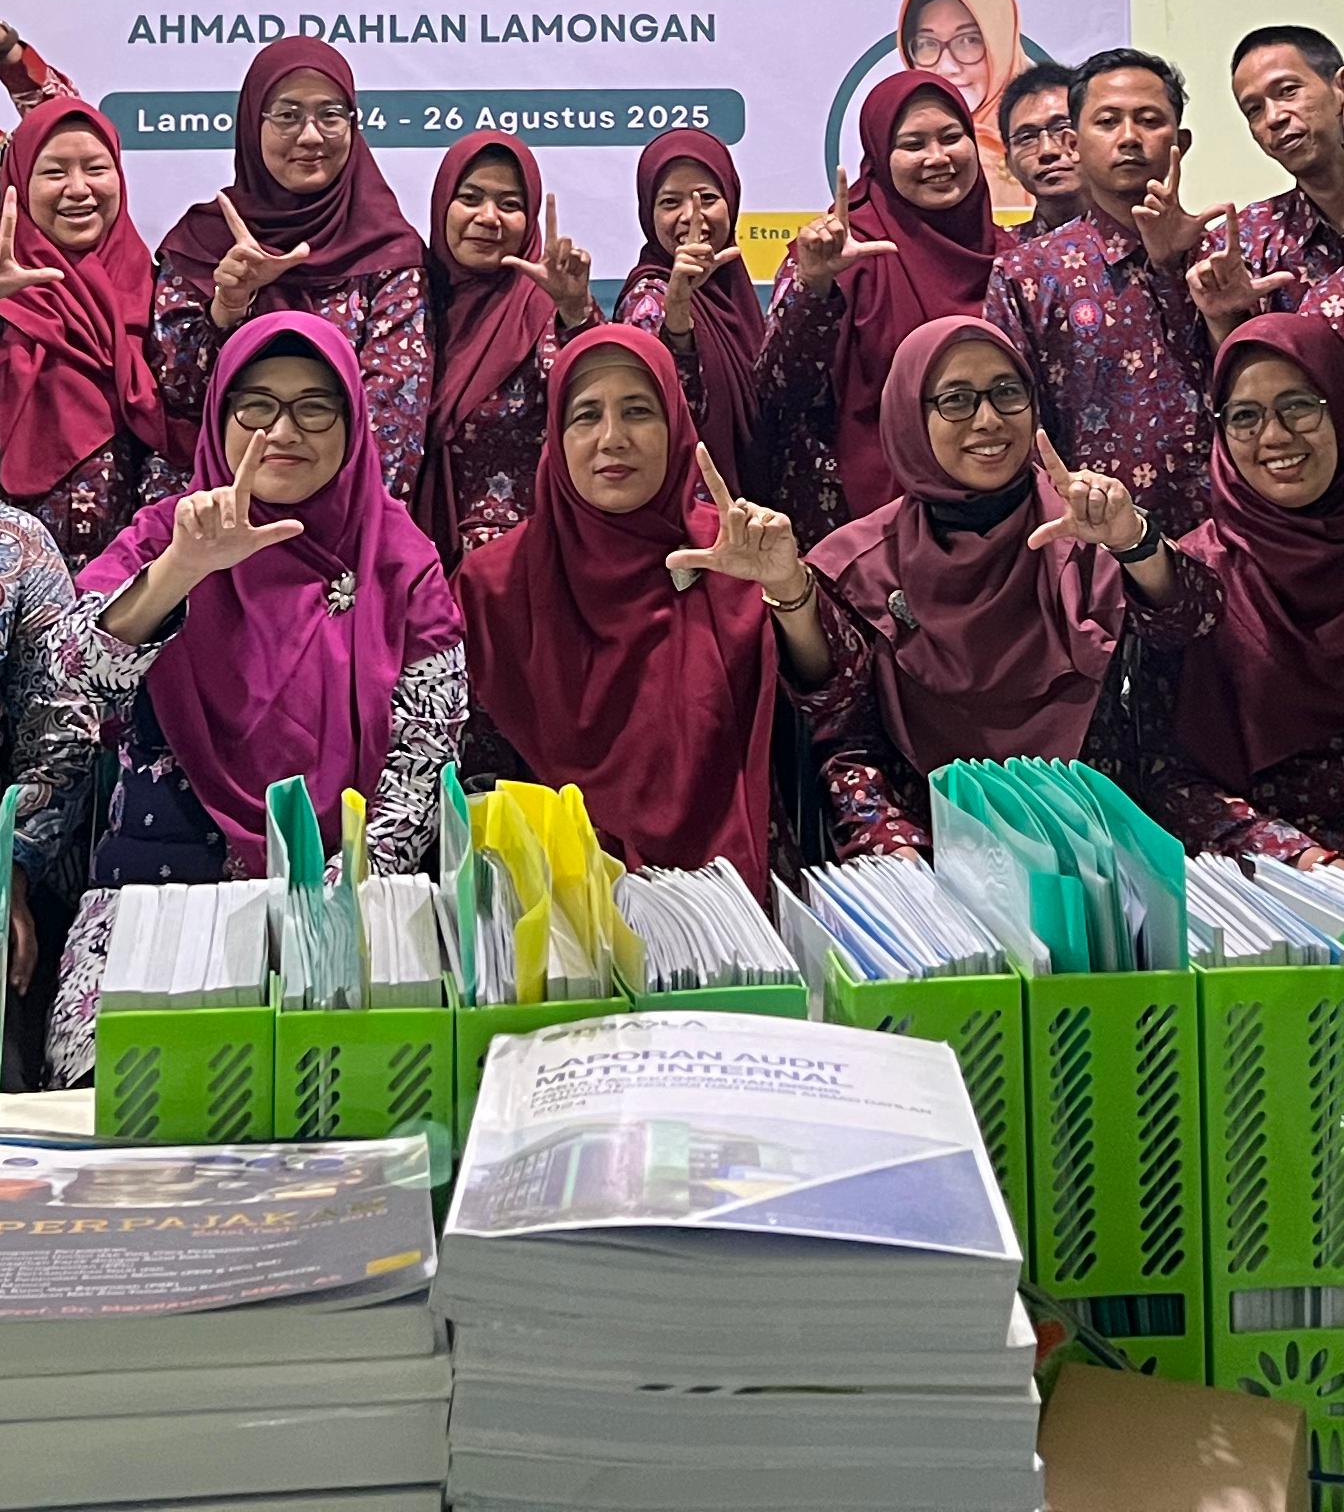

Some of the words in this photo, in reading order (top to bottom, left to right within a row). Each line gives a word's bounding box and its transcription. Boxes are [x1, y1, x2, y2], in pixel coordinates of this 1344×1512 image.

[127, 14, 286, 44] AHMAD
[299, 14, 466, 44] DAHLAN
[480, 13, 716, 43] LAMONGAN
[137, 108, 234, 133] Lamo
[423, 106, 464, 130] 26
[474, 106, 616, 135] Agustus
[626, 105, 710, 129] 2025
[749, 226, 791, 240] Etna
[537, 1049, 722, 1075] LAPORAN
[734, 1052, 850, 1073] AUDIT
[536, 1064, 645, 1088] MUTU
[657, 1063, 854, 1088] INTERNAL
